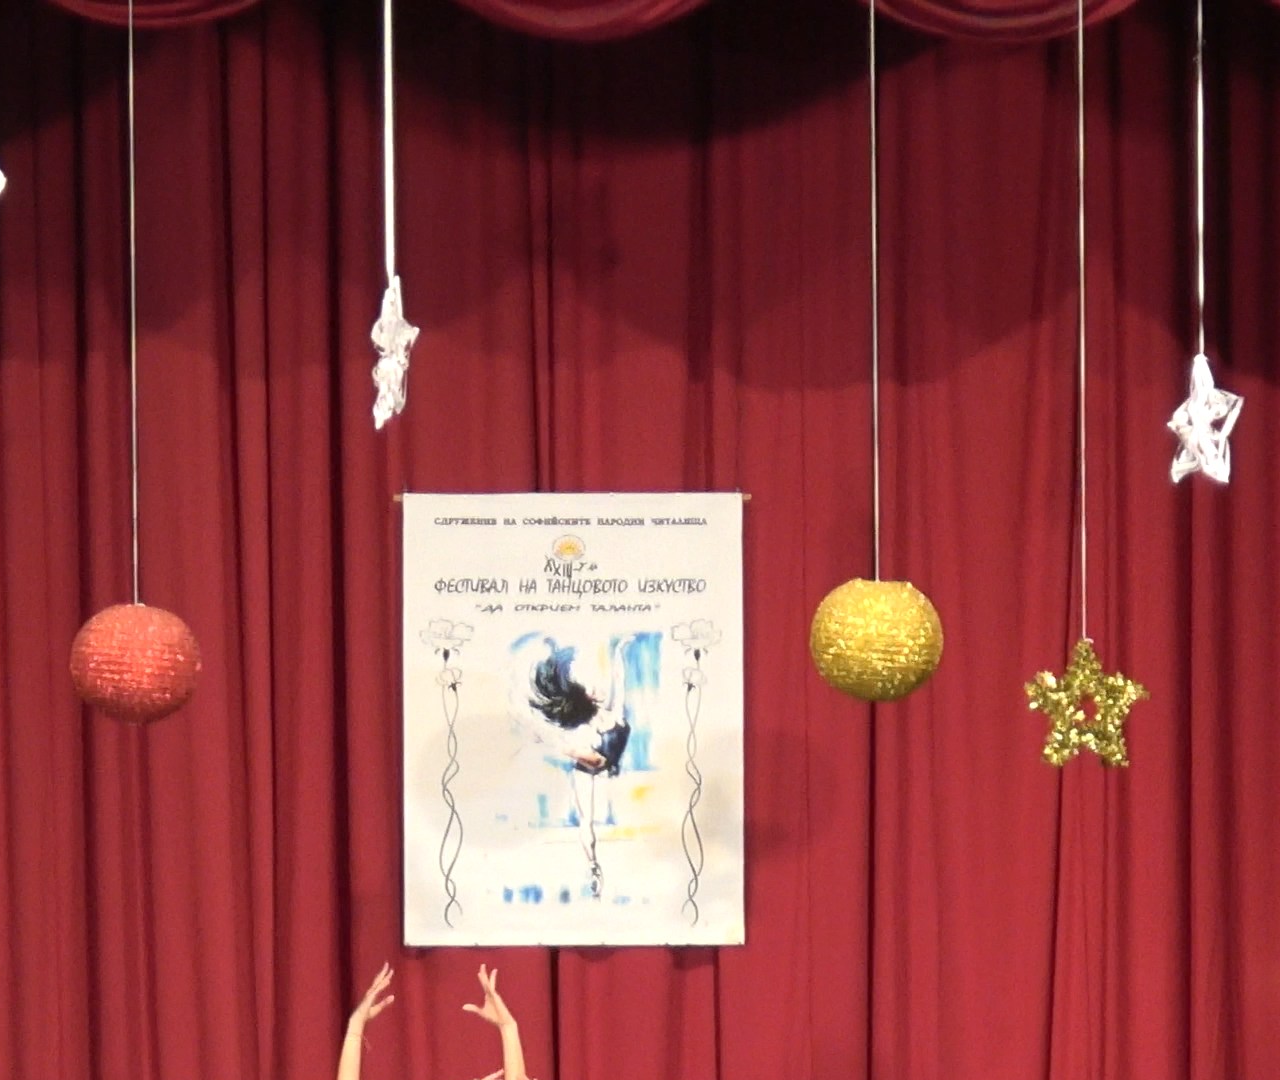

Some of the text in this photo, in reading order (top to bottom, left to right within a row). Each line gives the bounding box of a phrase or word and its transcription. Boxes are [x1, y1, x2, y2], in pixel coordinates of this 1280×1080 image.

[503, 517, 517, 526] НА
[433, 576, 708, 600] ФЕСТИВАЛ НА ТАНЦОВОТО ИЗКУСТВО
[513, 603, 581, 613] ОТКРИЕМ
